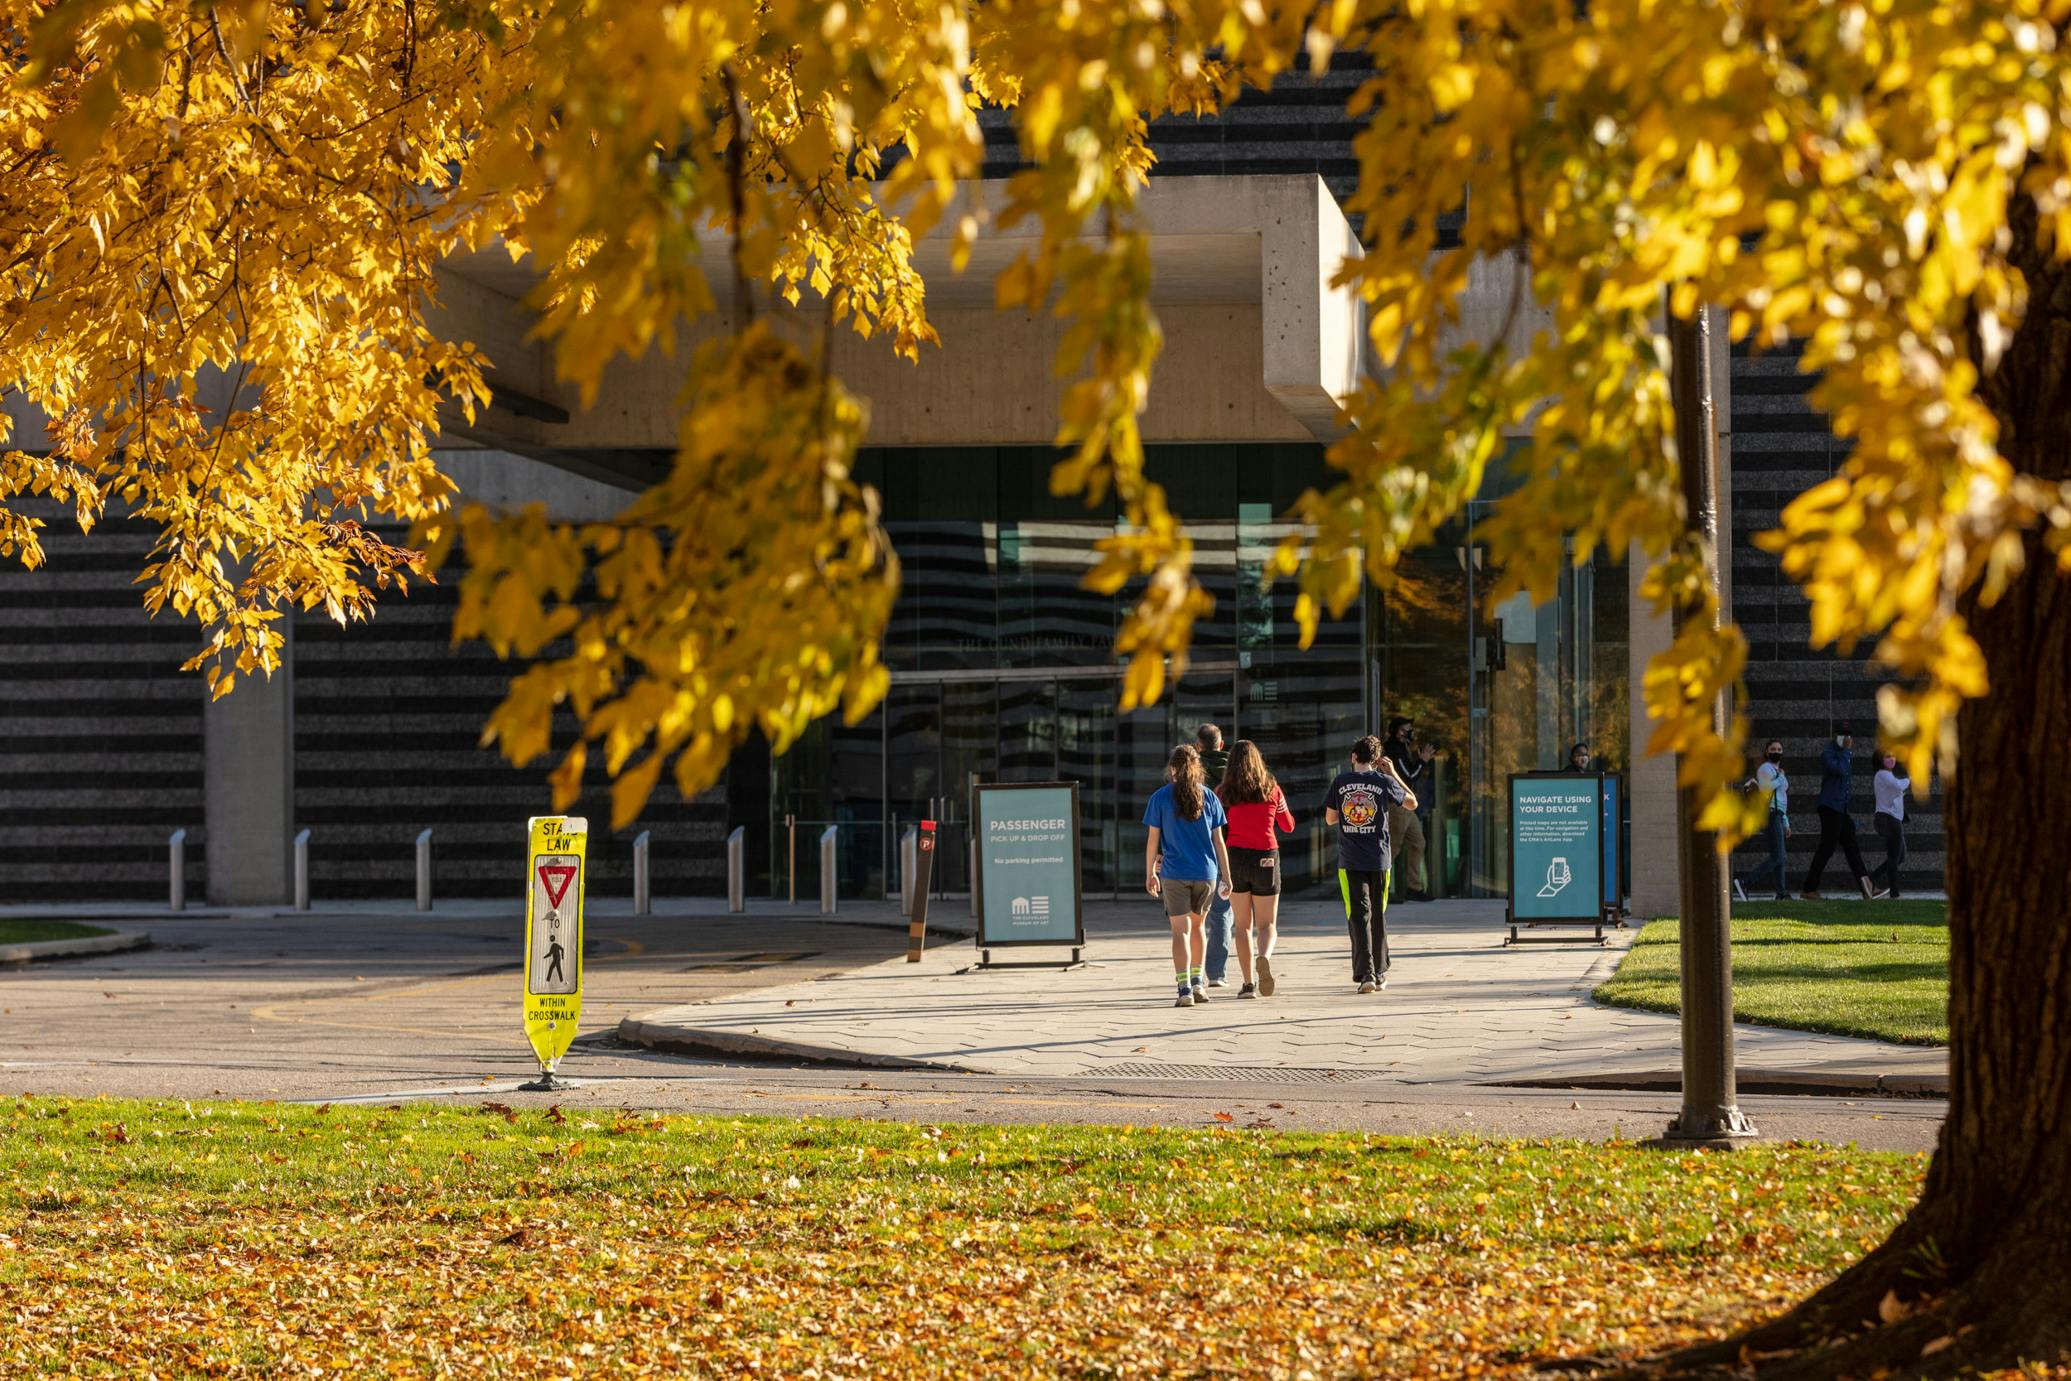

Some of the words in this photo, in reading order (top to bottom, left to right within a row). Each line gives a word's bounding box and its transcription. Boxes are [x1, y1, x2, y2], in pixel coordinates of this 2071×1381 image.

[1339, 783, 1383, 795] CLEVELAND
[1520, 796, 1563, 804] NAVIGATE
[1565, 795, 1592, 804] USING
[1546, 805, 1578, 813] DEVICE
[990, 819, 1066, 831] PASSENGER
[1359, 825, 1376, 834] CITY
[547, 839, 571, 851] LAW
[1005, 857, 1030, 865] parking
[1031, 856, 1063, 864] permitted
[550, 919, 560, 928] TO
[540, 998, 565, 1007] WITHIN
[529, 1010, 575, 1020] CROSSWALK
